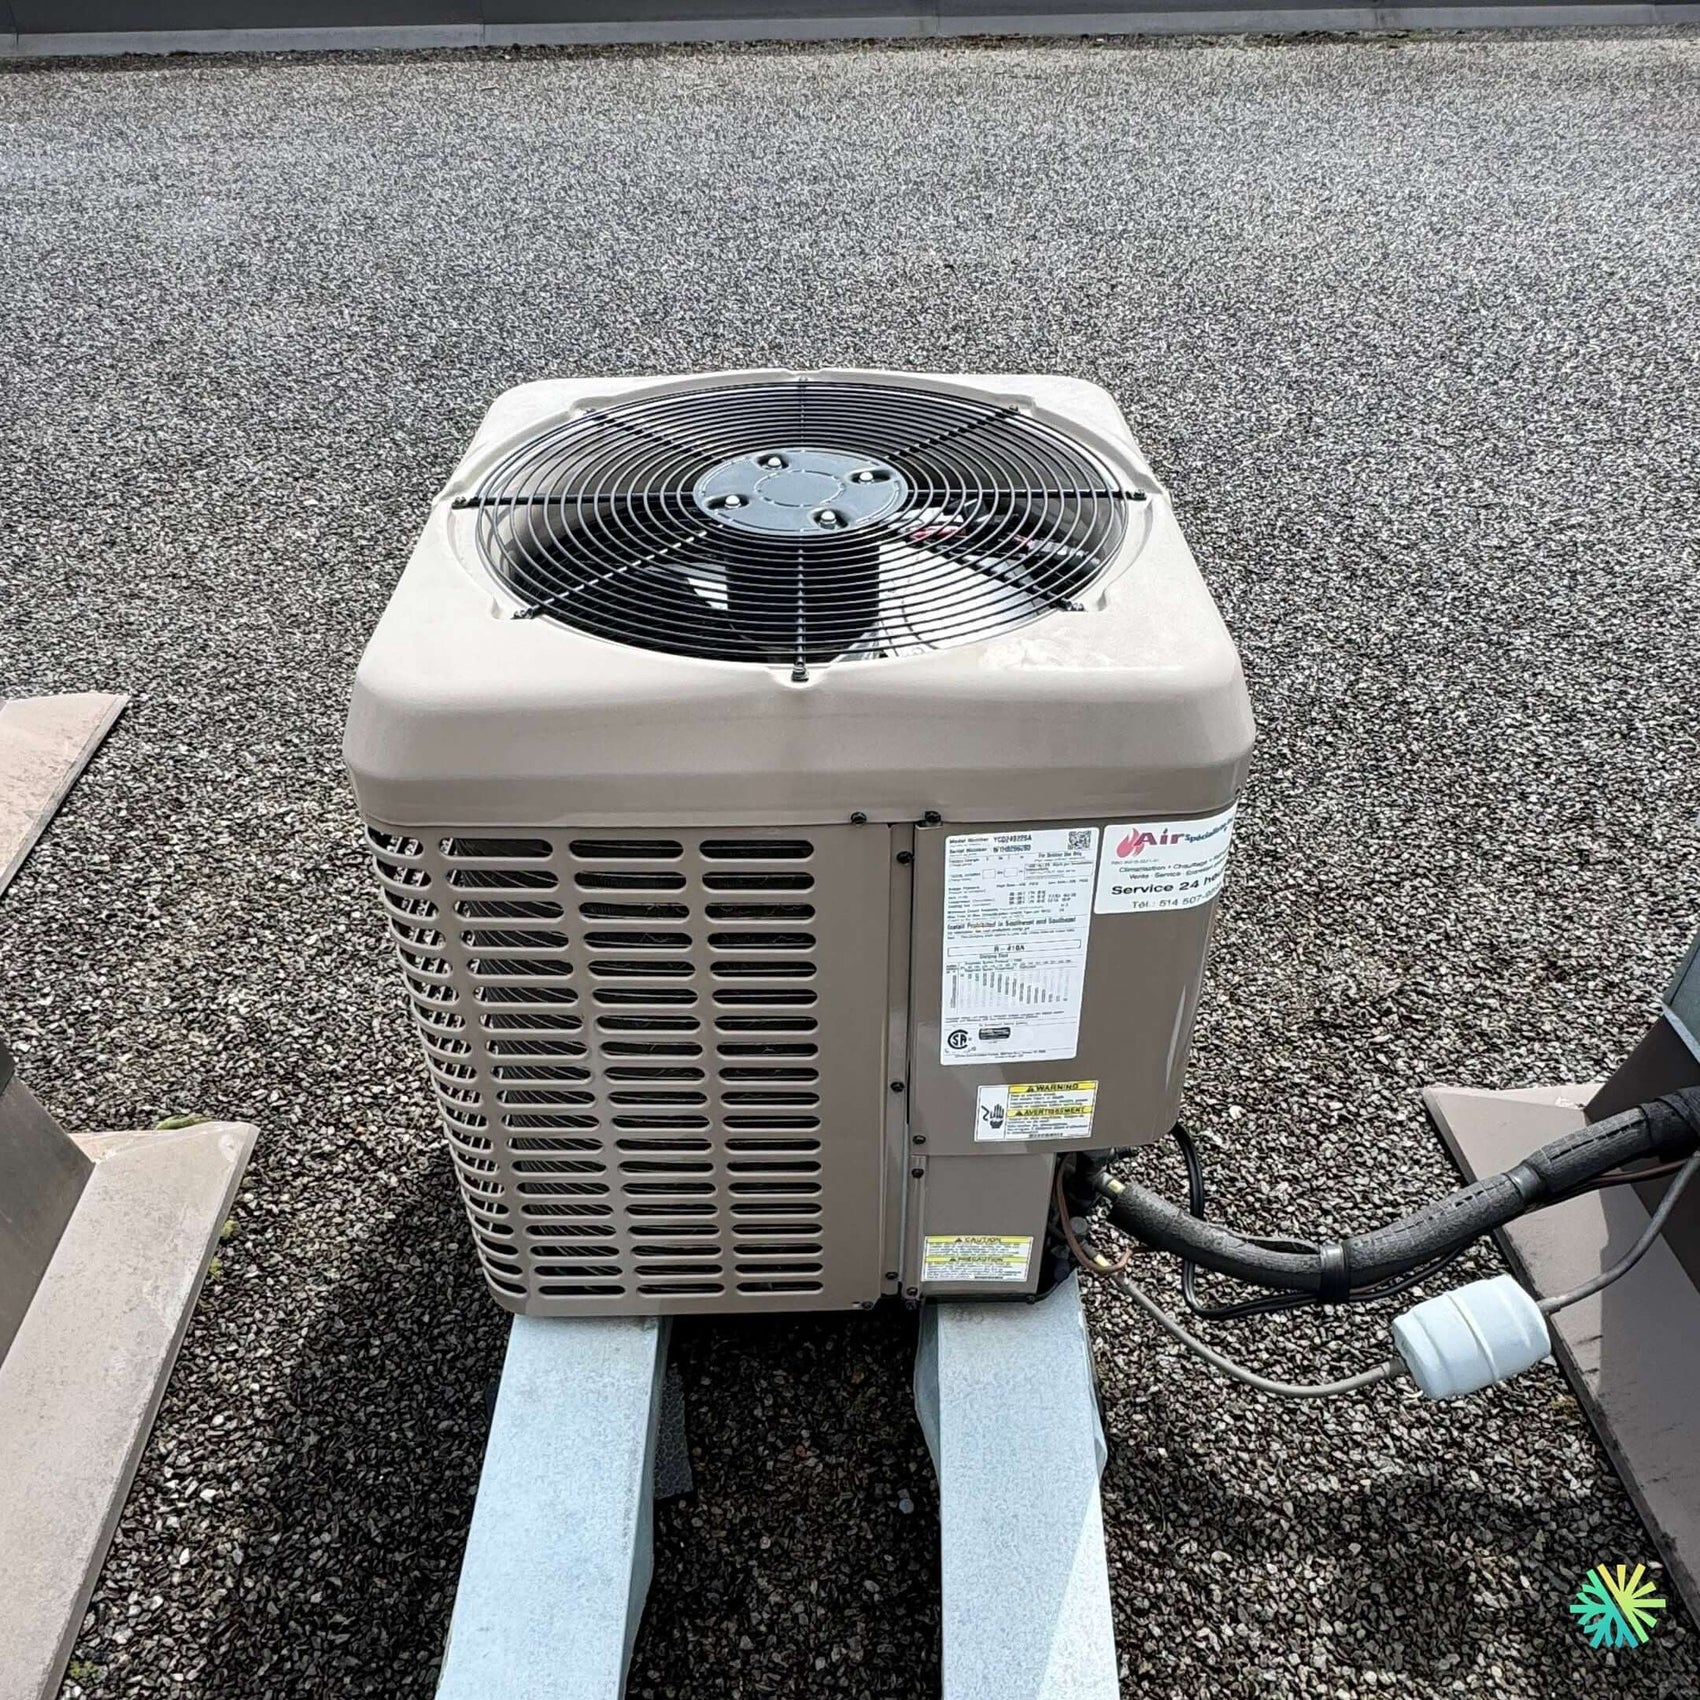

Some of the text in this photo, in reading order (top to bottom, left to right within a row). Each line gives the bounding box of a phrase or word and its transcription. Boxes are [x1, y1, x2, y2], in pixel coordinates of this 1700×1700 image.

[1134, 828, 1184, 846] Air
[1111, 884, 1174, 895] Service
[1179, 879, 1200, 891] 24
[1159, 898, 1179, 908] 514
[1036, 1083, 1079, 1092] WARNING
